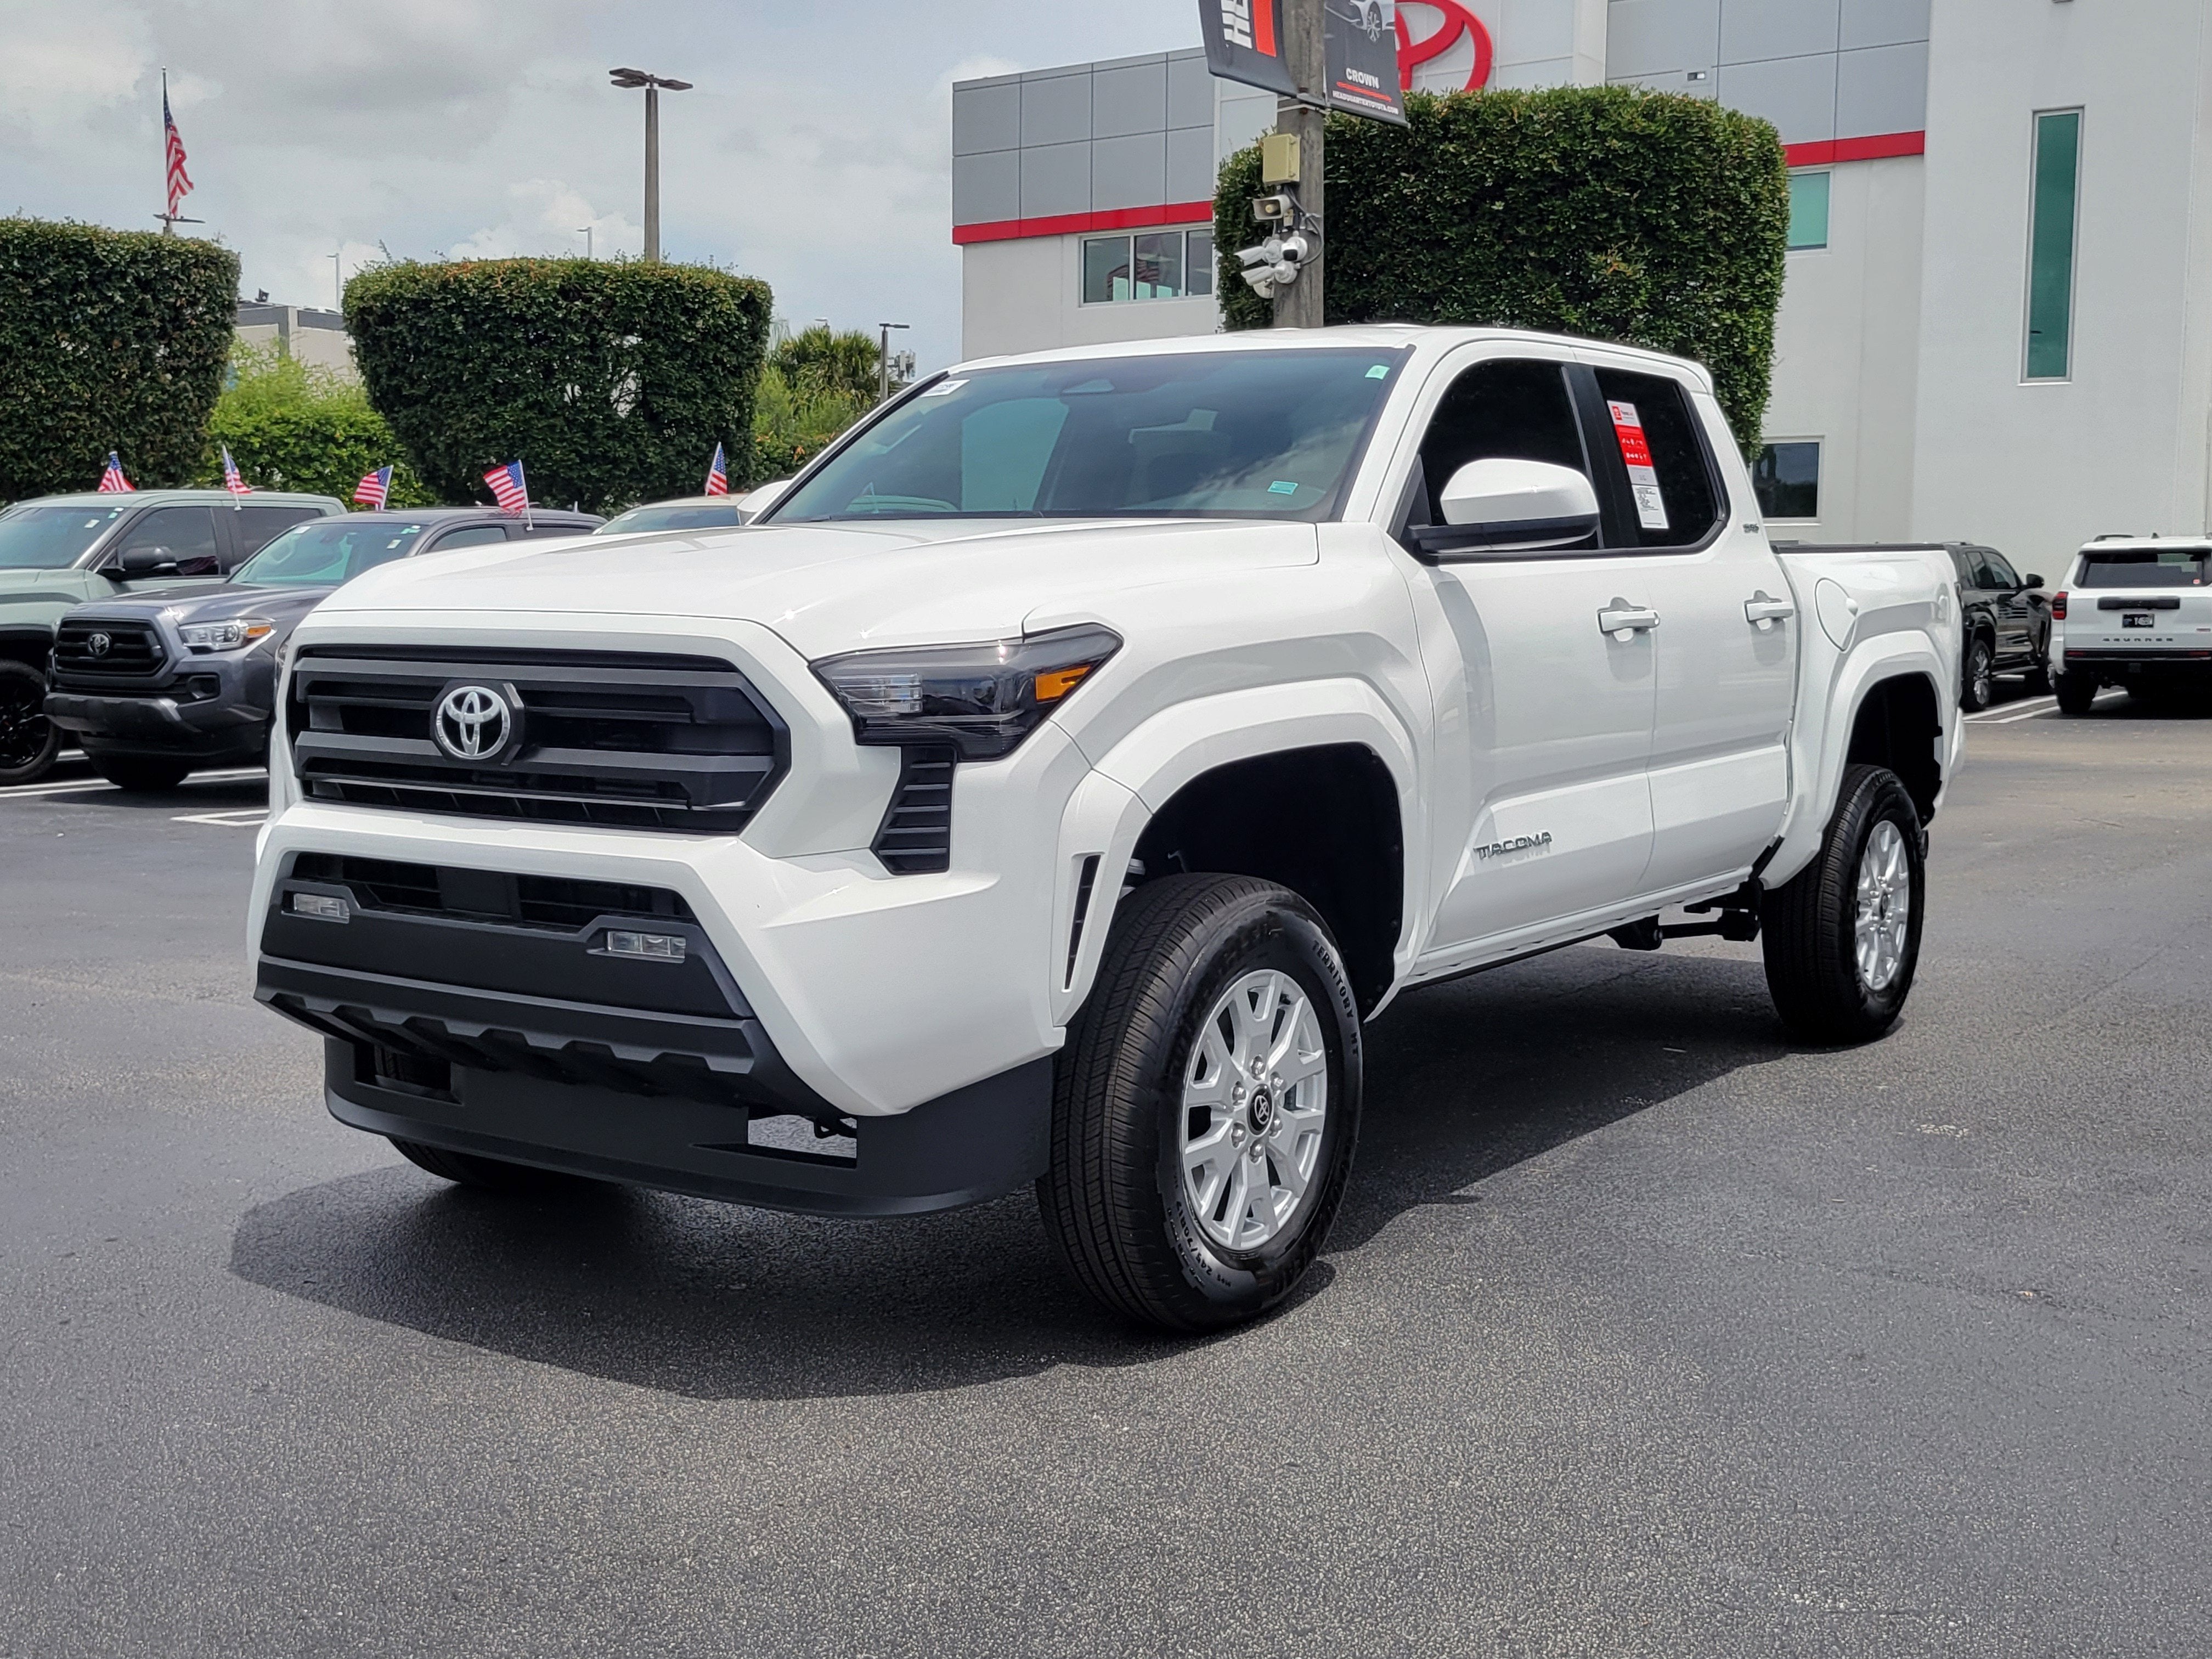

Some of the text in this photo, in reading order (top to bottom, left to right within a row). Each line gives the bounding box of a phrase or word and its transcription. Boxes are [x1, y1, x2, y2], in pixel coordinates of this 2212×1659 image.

[1346, 67, 1380, 89] CROWN
[1473, 832, 1552, 860] TACOMA
[1312, 939, 1355, 1019] TERRITORY
[1176, 1200, 1212, 1276] 245/70R17
